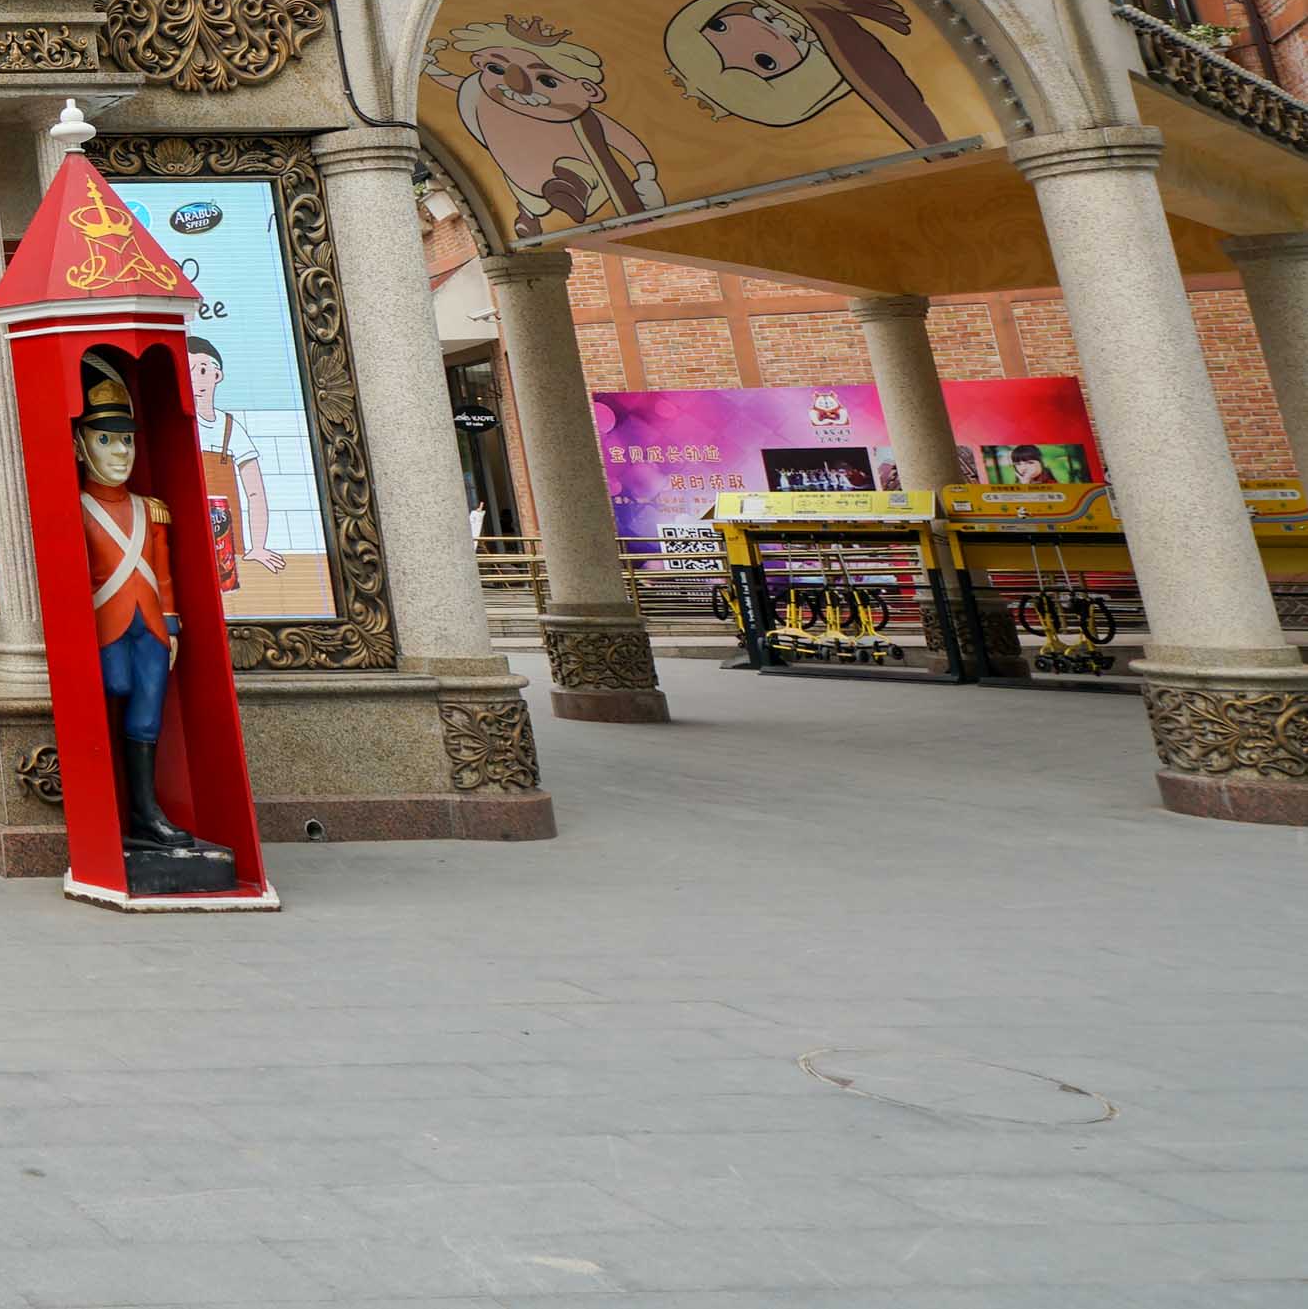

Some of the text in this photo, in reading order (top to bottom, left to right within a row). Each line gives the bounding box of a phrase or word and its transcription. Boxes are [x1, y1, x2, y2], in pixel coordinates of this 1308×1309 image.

[174, 207, 218, 225] ARABUS
[184, 219, 210, 230] SPEED
[608, 444, 722, 464] 宝贝成长轨迹
[670, 474, 746, 491] 限时领取
